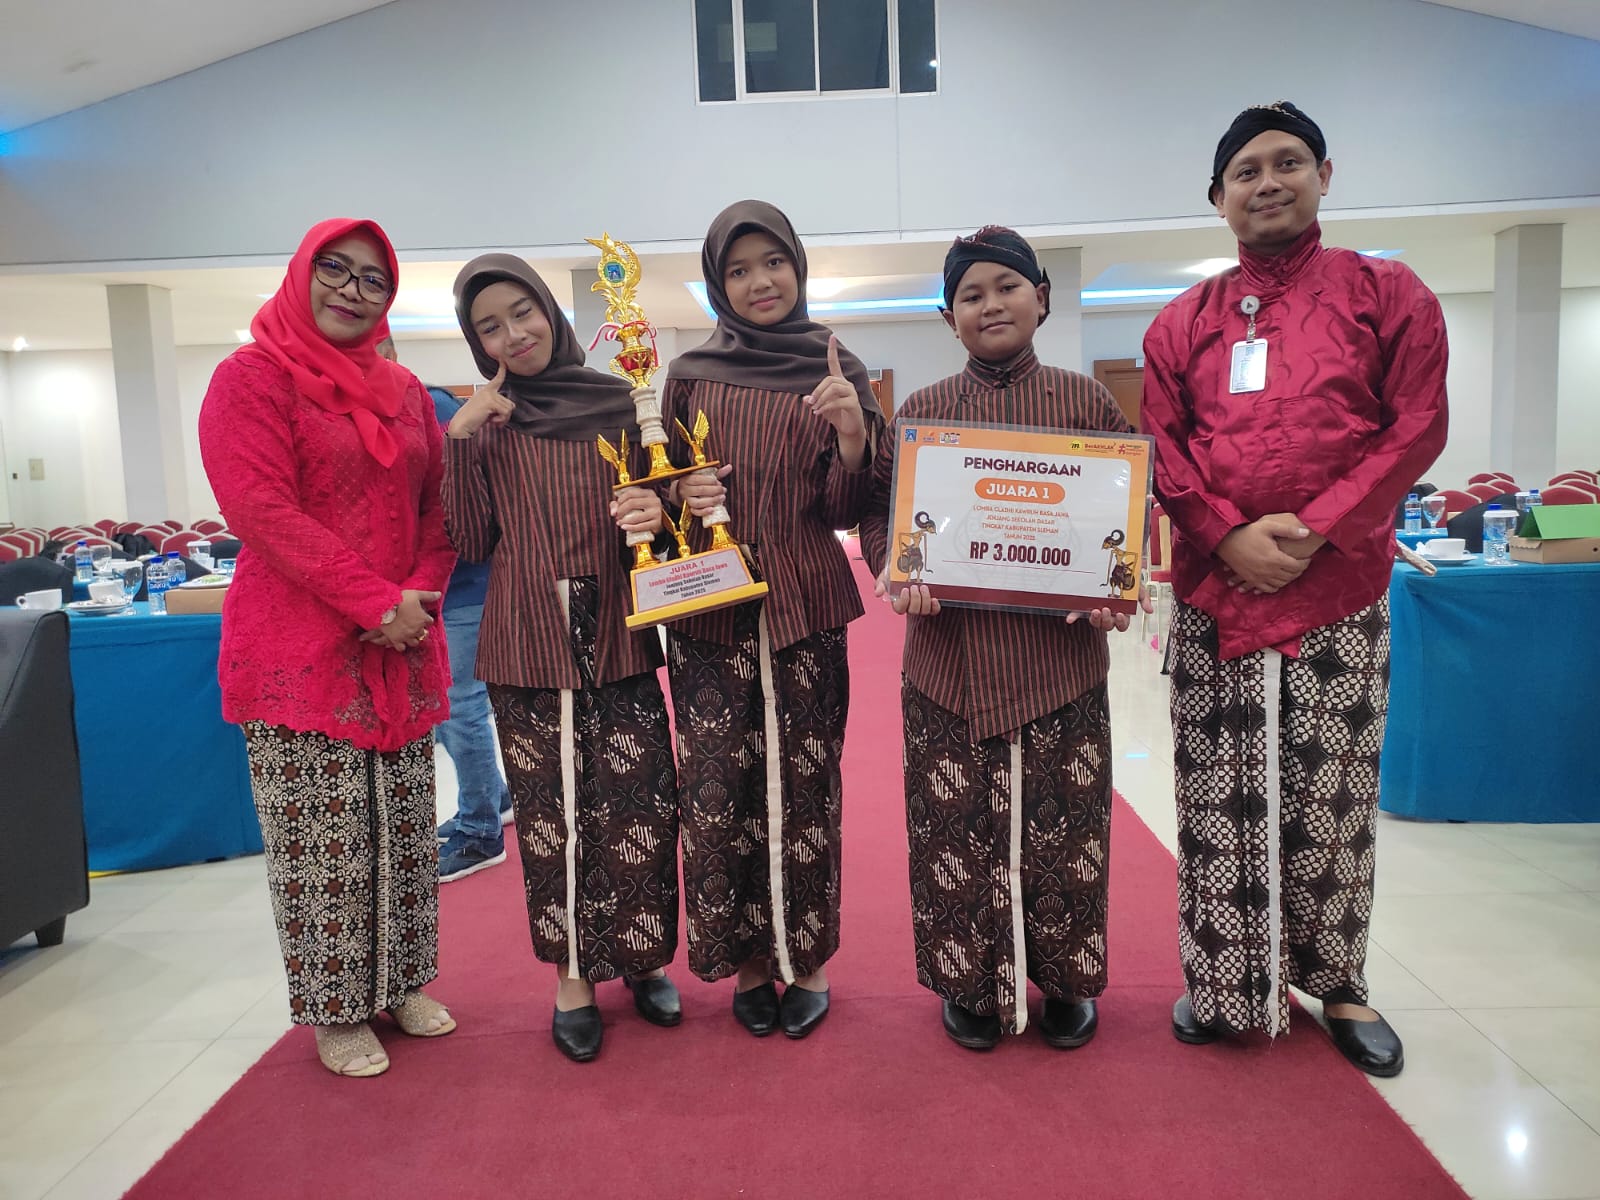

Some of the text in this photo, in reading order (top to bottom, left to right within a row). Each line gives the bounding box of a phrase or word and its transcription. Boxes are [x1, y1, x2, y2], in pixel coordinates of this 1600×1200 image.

[964, 457, 1081, 476] PENGHARGAAN
[985, 483, 1050, 499] JUARA 1
[982, 522, 1004, 530] TINGKAT
[969, 541, 1071, 566] RP 3.000.000
[671, 562, 697, 574] JUARA
